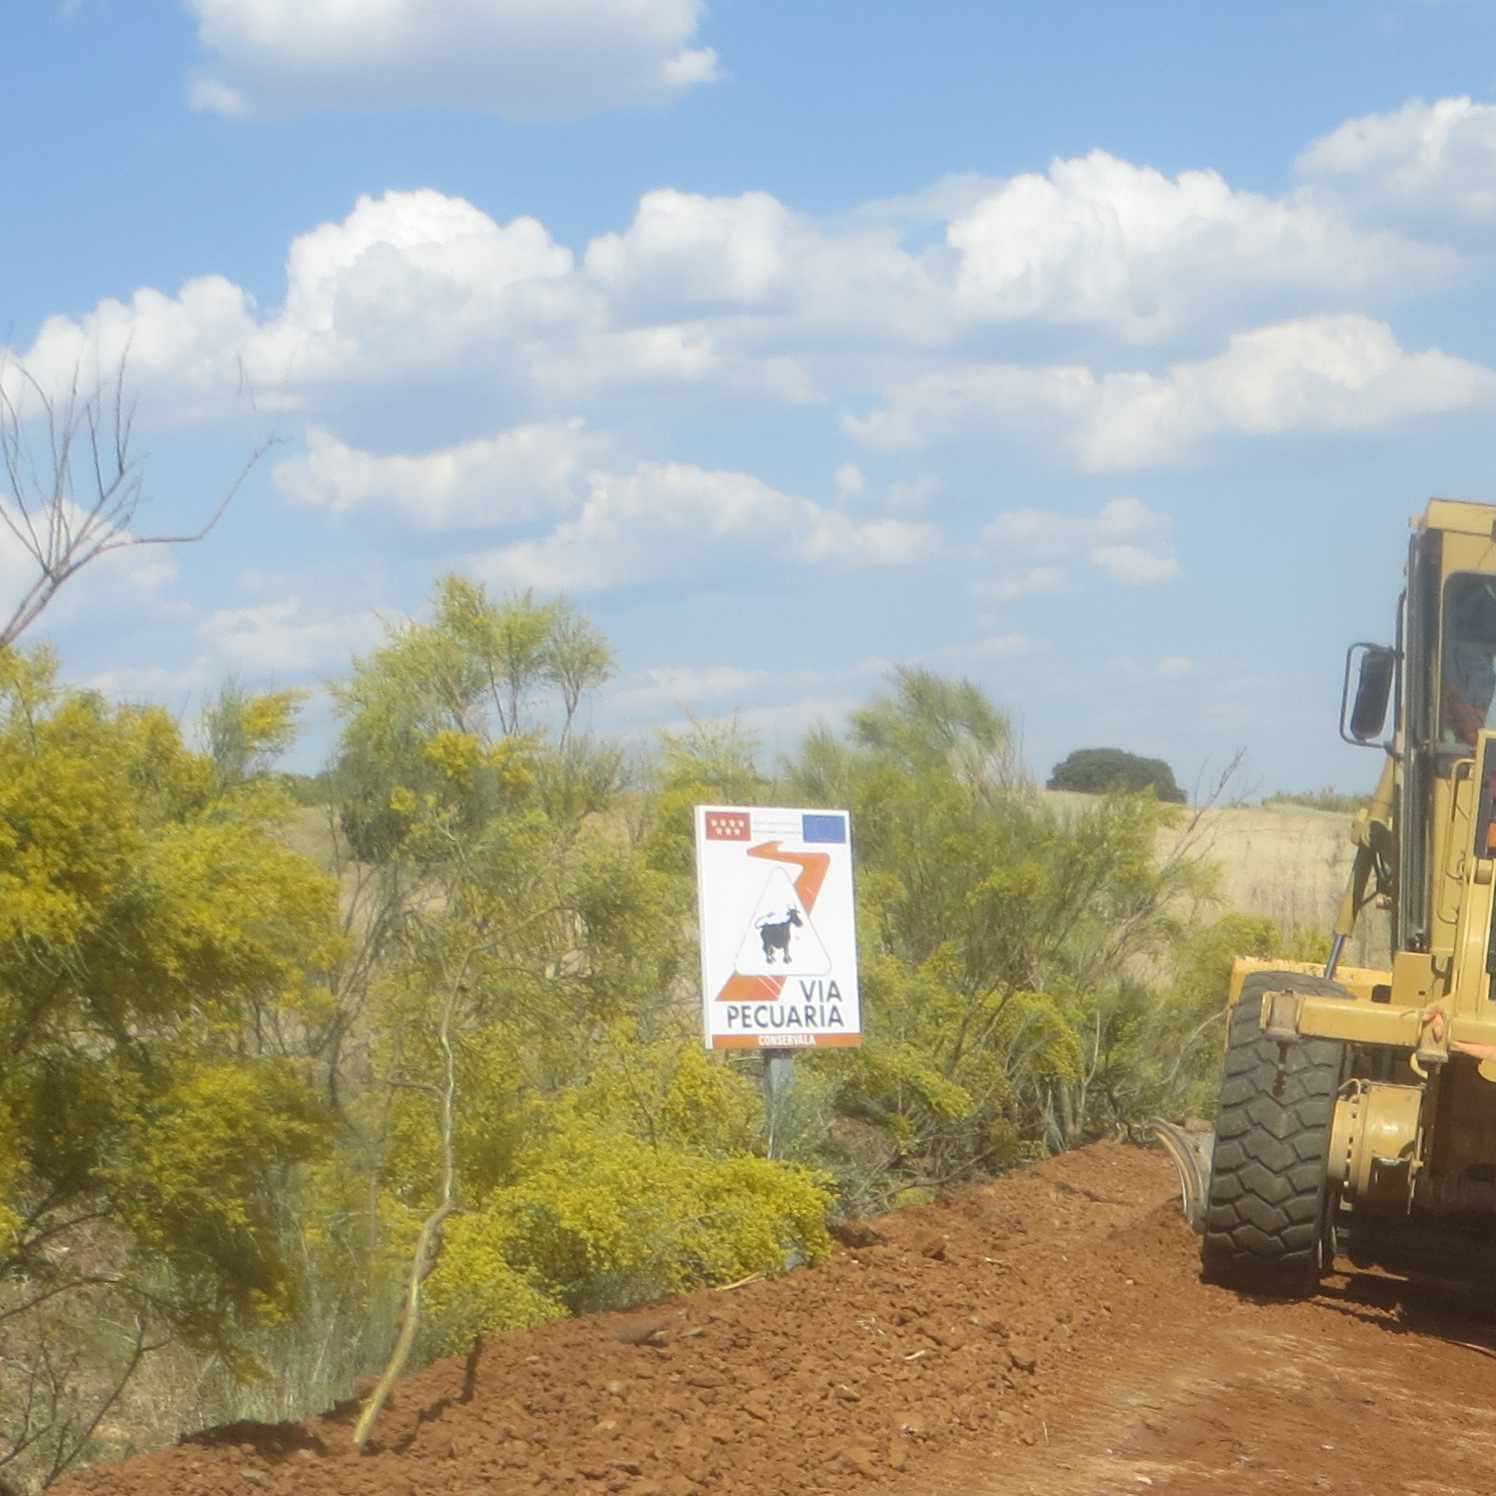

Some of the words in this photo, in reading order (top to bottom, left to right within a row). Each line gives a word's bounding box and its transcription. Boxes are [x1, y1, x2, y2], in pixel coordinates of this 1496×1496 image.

[800, 980, 843, 1002] VIA
[727, 1005, 845, 1028] PECUARIA
[758, 1034, 816, 1046] CONSERVALA
